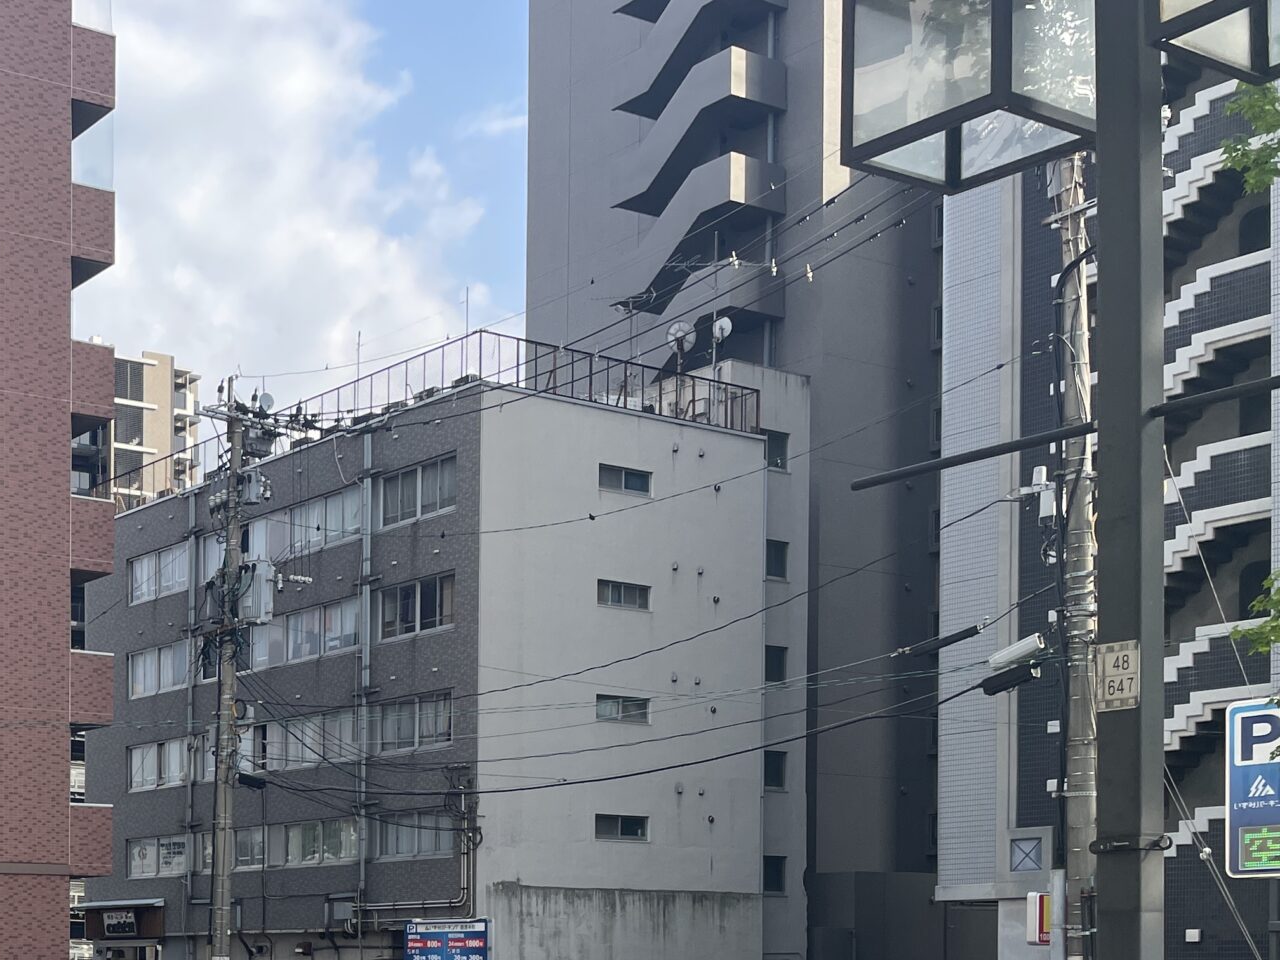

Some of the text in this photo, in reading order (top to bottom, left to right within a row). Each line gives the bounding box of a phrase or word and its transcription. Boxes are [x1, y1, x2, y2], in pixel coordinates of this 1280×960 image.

[1113, 654, 1129, 671] 48
[1108, 677, 1134, 696] 647
[1241, 714, 1280, 761] P
